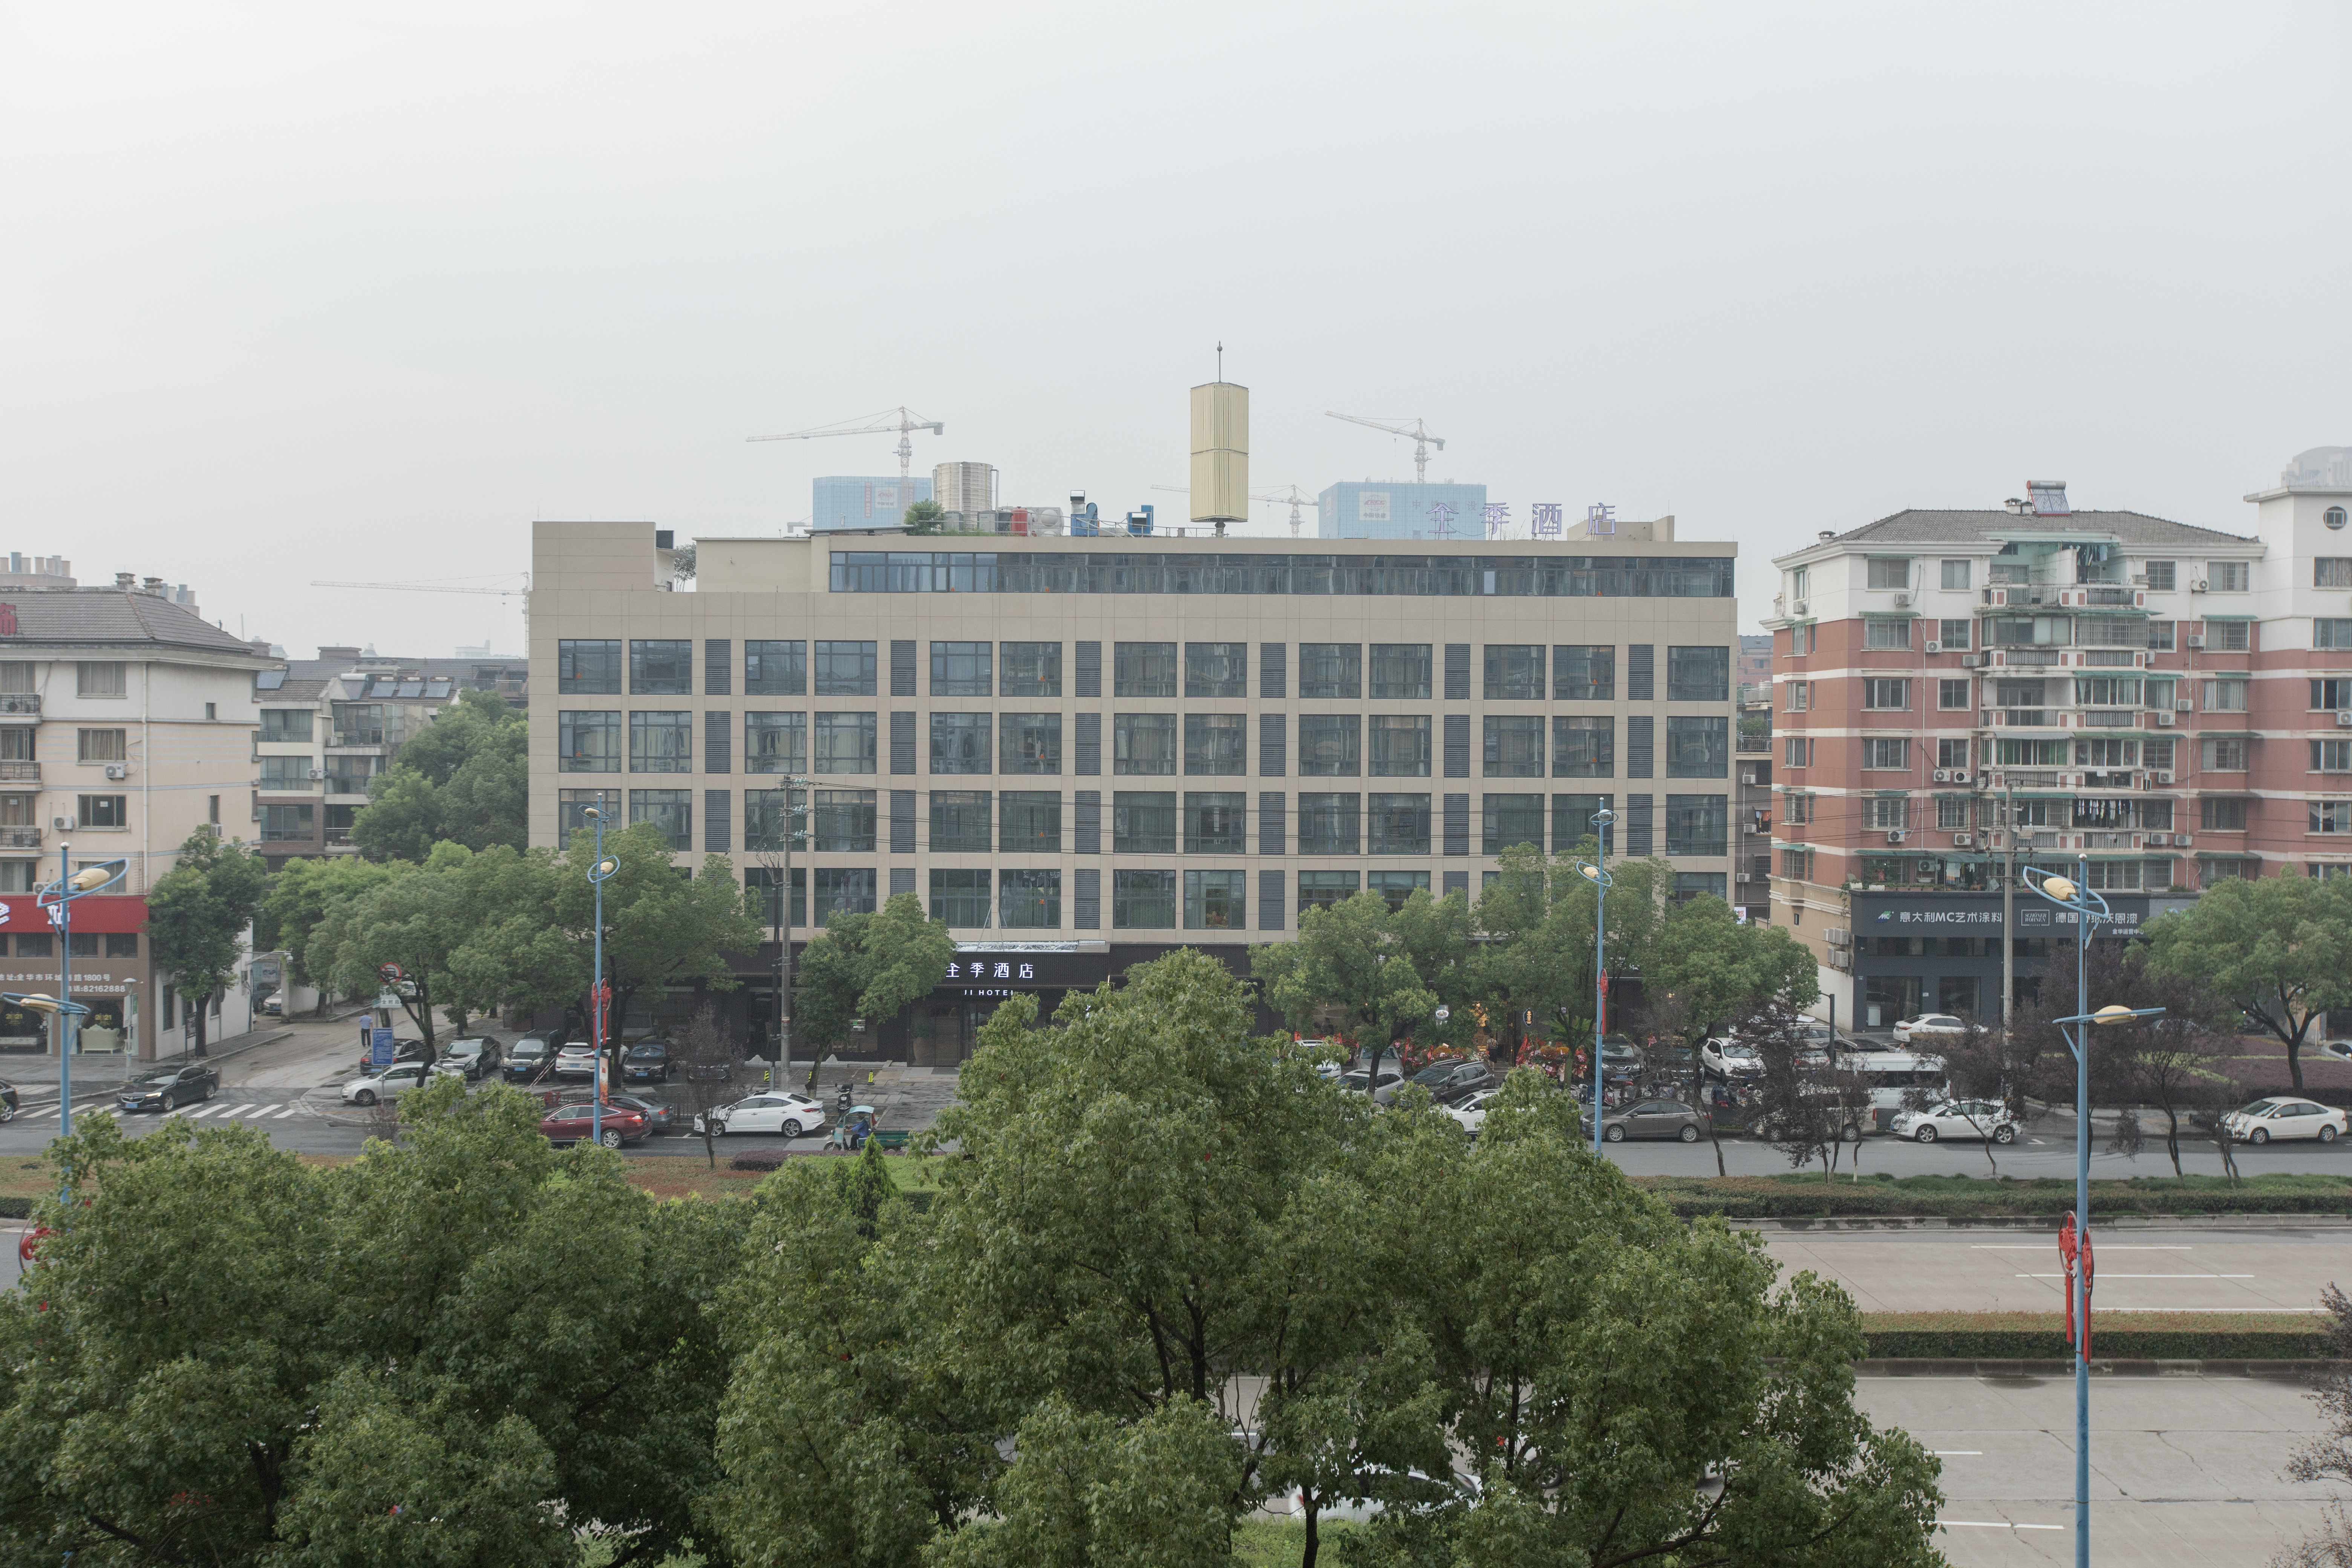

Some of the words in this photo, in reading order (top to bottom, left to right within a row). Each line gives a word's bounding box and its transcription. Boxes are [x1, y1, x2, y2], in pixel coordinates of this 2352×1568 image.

[1426, 502, 1615, 535] 全季酒店
[1900, 911, 2002, 923] 意大利MC艺术涂料
[945, 962, 1034, 979] 全季酒店
